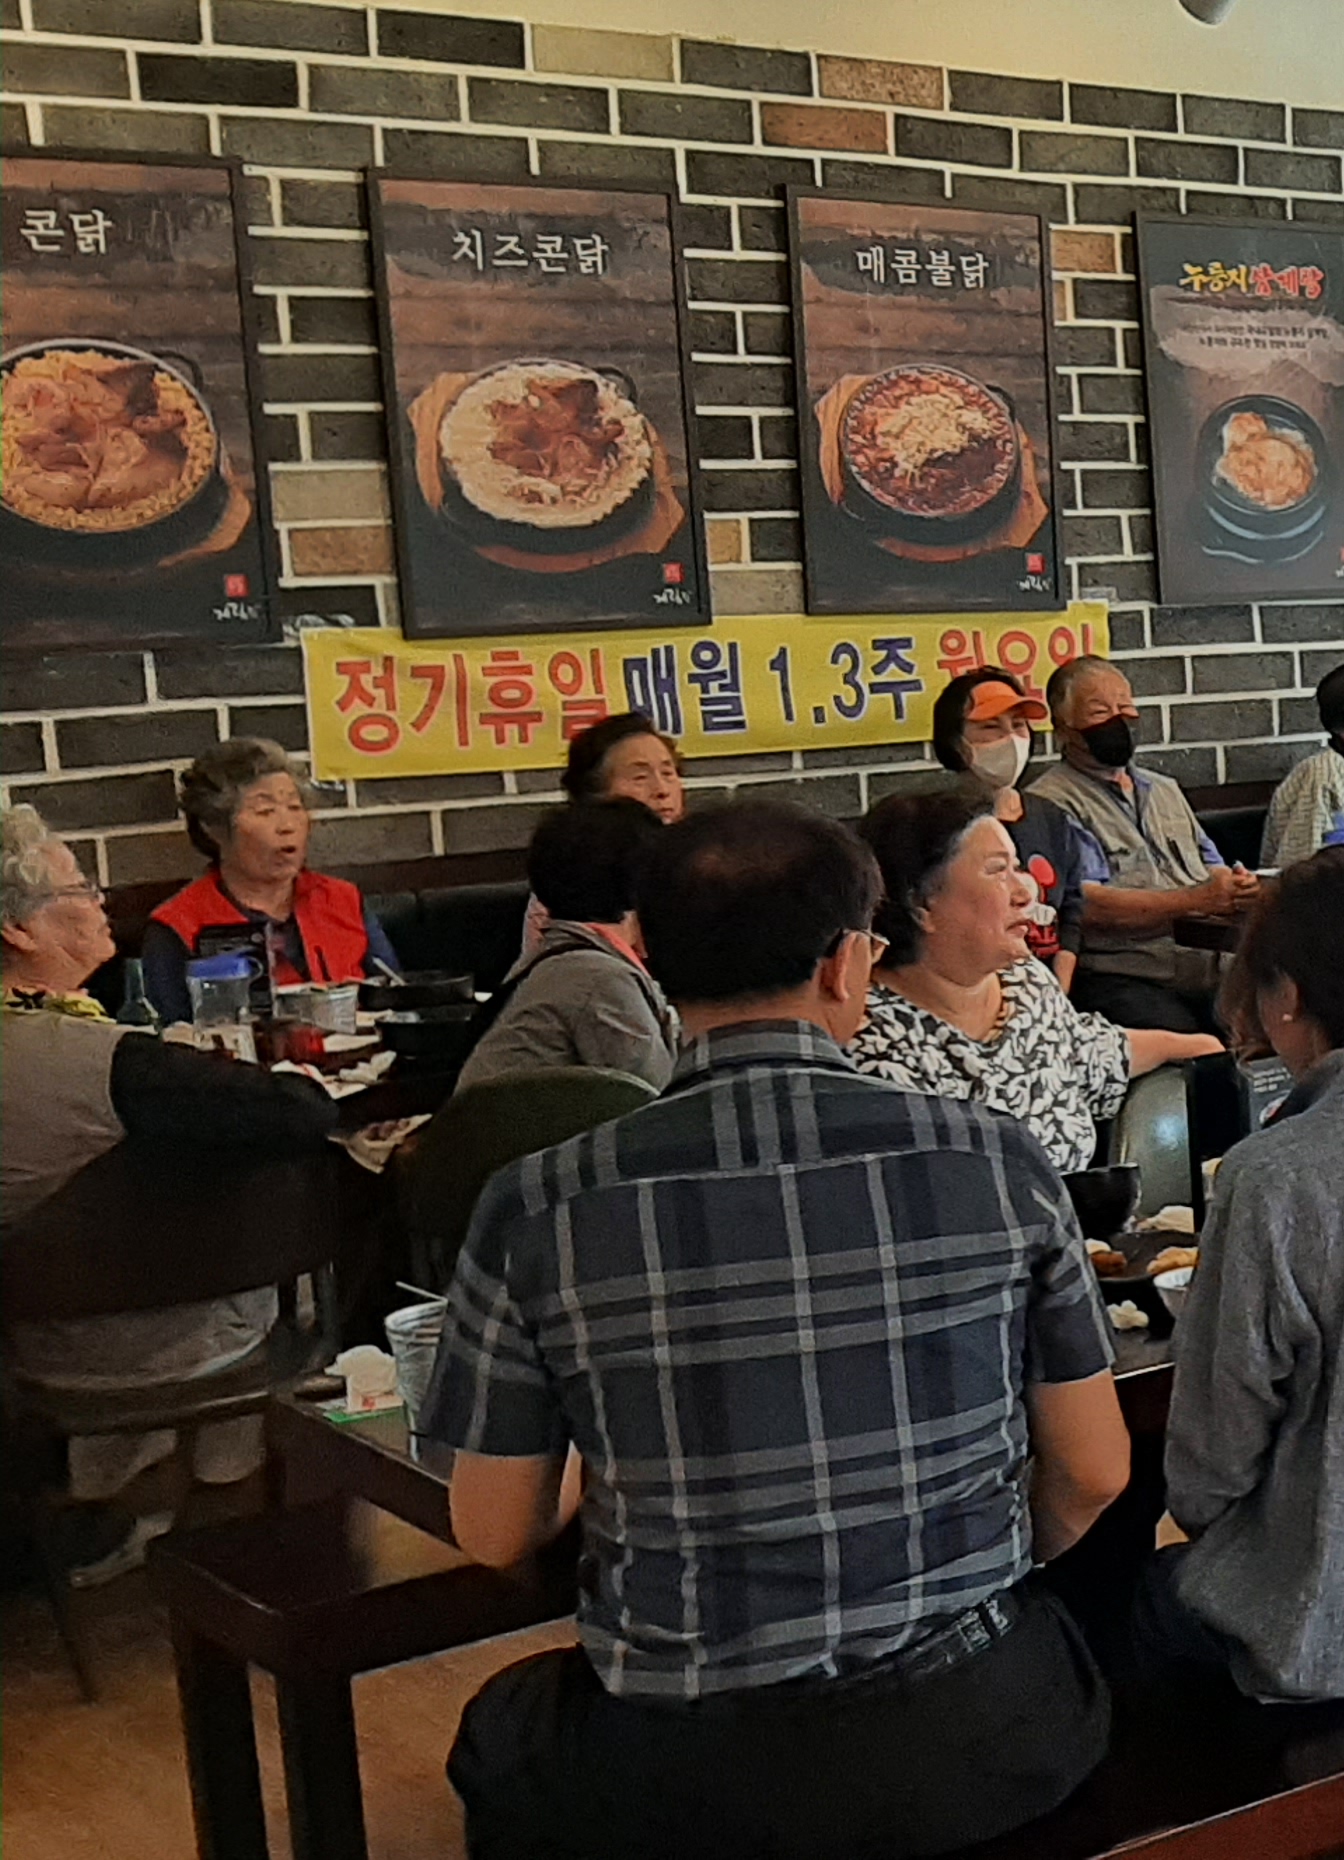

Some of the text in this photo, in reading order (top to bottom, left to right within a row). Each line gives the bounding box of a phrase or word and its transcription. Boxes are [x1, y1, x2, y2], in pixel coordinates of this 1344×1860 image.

[19, 209, 115, 255] 콘닭
[450, 229, 610, 276] 치즈콘닭
[854, 246, 990, 292] 매콤불닭
[334, 649, 610, 752] 정기휴일
[622, 640, 748, 736] 매월
[766, 635, 923, 726] 1.3주
